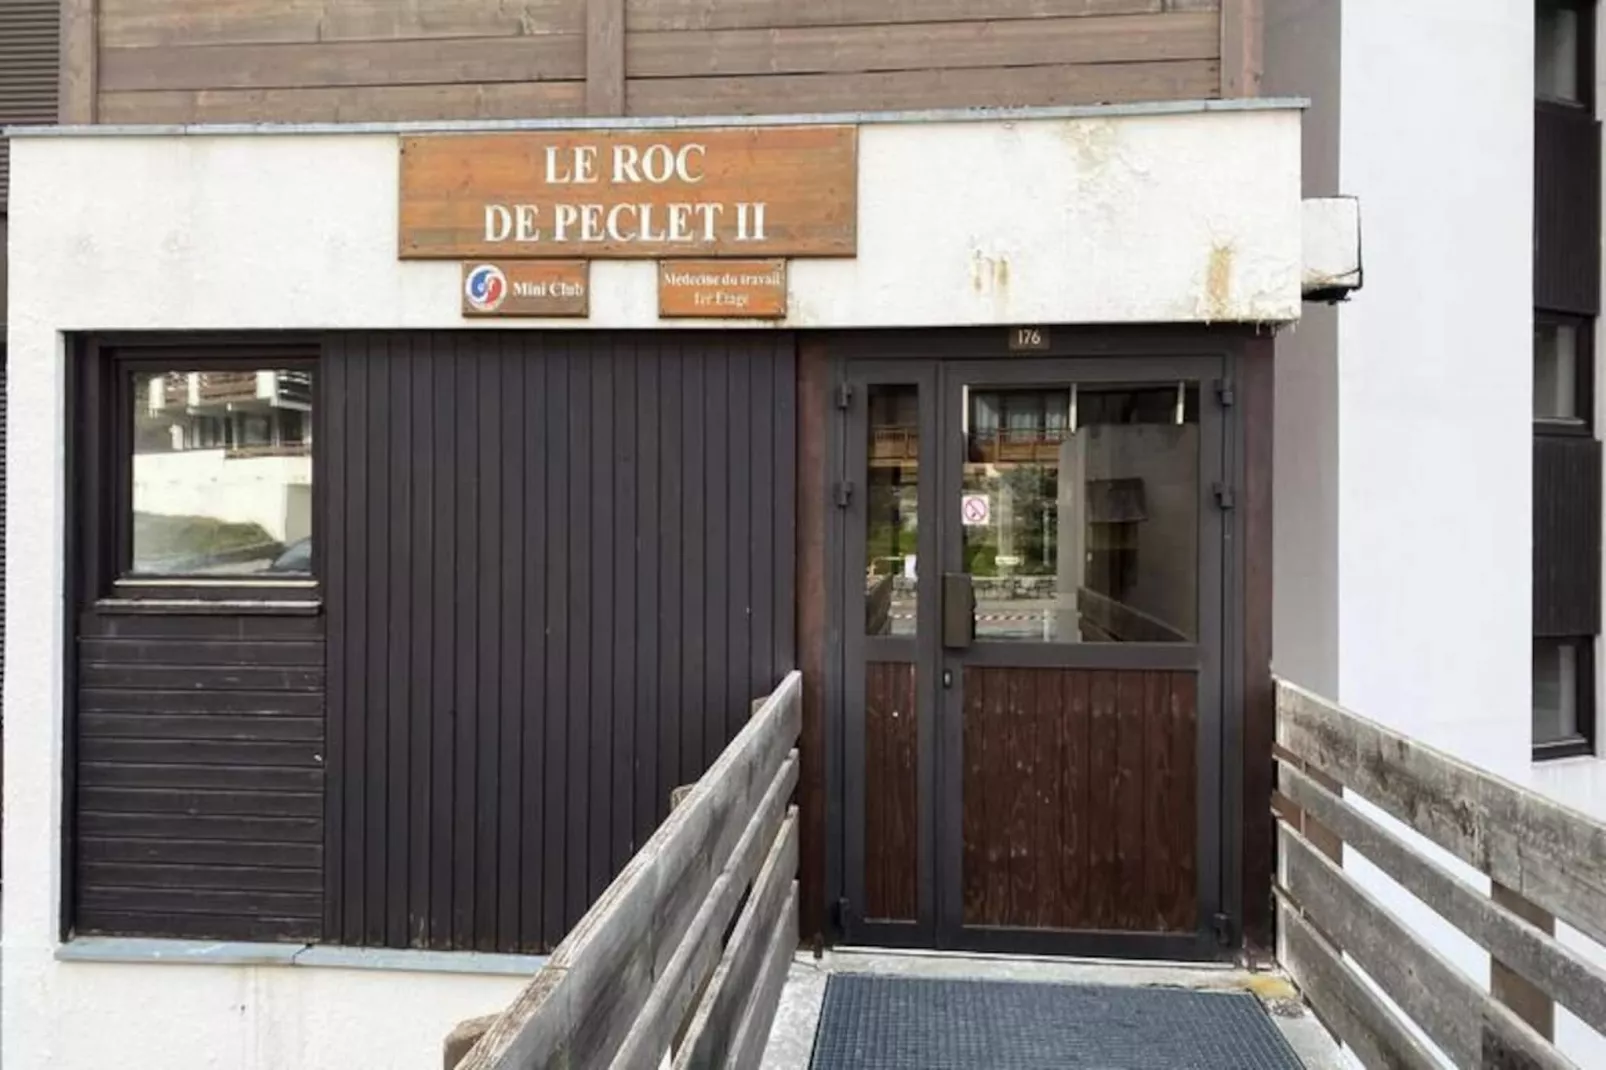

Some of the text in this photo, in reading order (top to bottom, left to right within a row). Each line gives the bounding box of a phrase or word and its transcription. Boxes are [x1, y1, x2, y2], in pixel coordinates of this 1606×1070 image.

[545, 143, 707, 184] LE ROC
[484, 202, 768, 242] DE PECLET II
[722, 273, 738, 286] du
[740, 271, 781, 286] travail
[512, 281, 585, 297] Mini Club
[1018, 329, 1042, 345] 176
